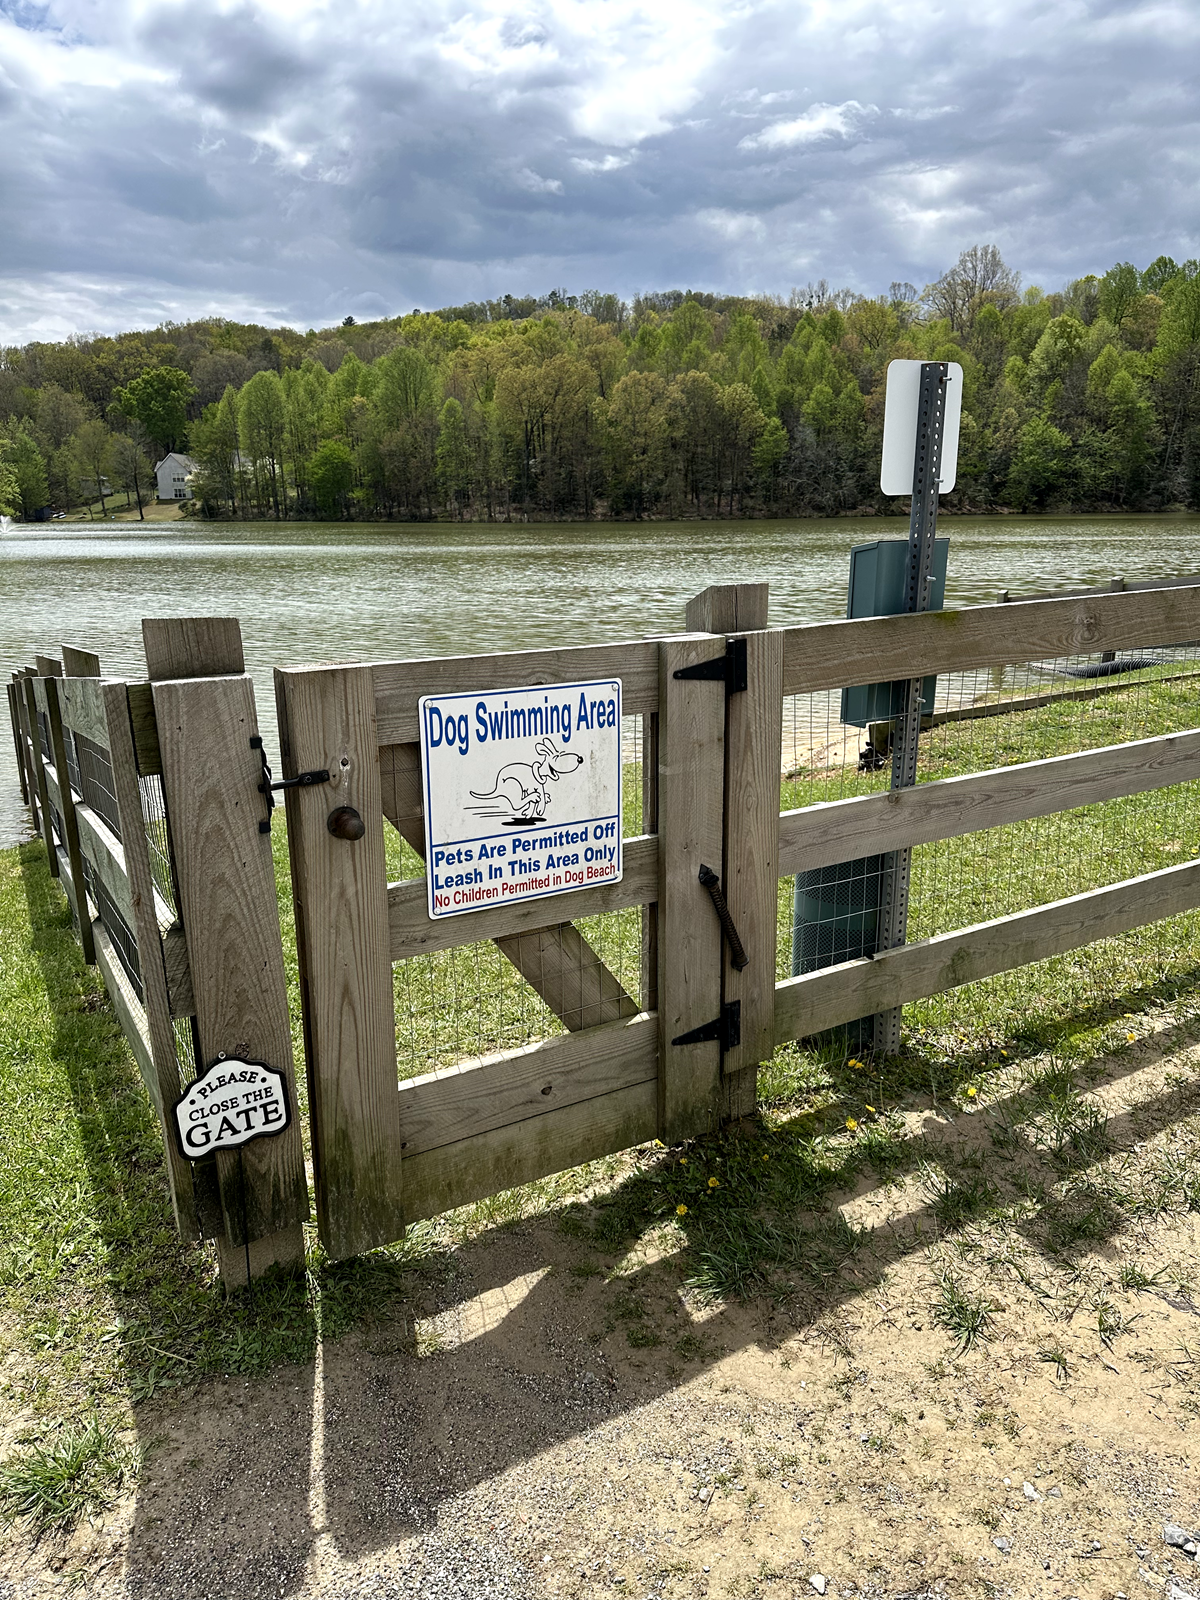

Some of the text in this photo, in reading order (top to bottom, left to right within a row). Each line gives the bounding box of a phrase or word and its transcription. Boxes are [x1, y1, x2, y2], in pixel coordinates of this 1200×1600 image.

[429, 692, 616, 755] Dog Swimming Area
[434, 822, 616, 868] Pets Are Permitted Off
[434, 844, 616, 890] Leash In This Area Only
[435, 862, 616, 908] No Children Permitted in Dog Beach
[188, 1086, 274, 1121] CLOSE THE
[197, 1071, 259, 1100] PLEASE
[185, 1099, 283, 1148] GATE
